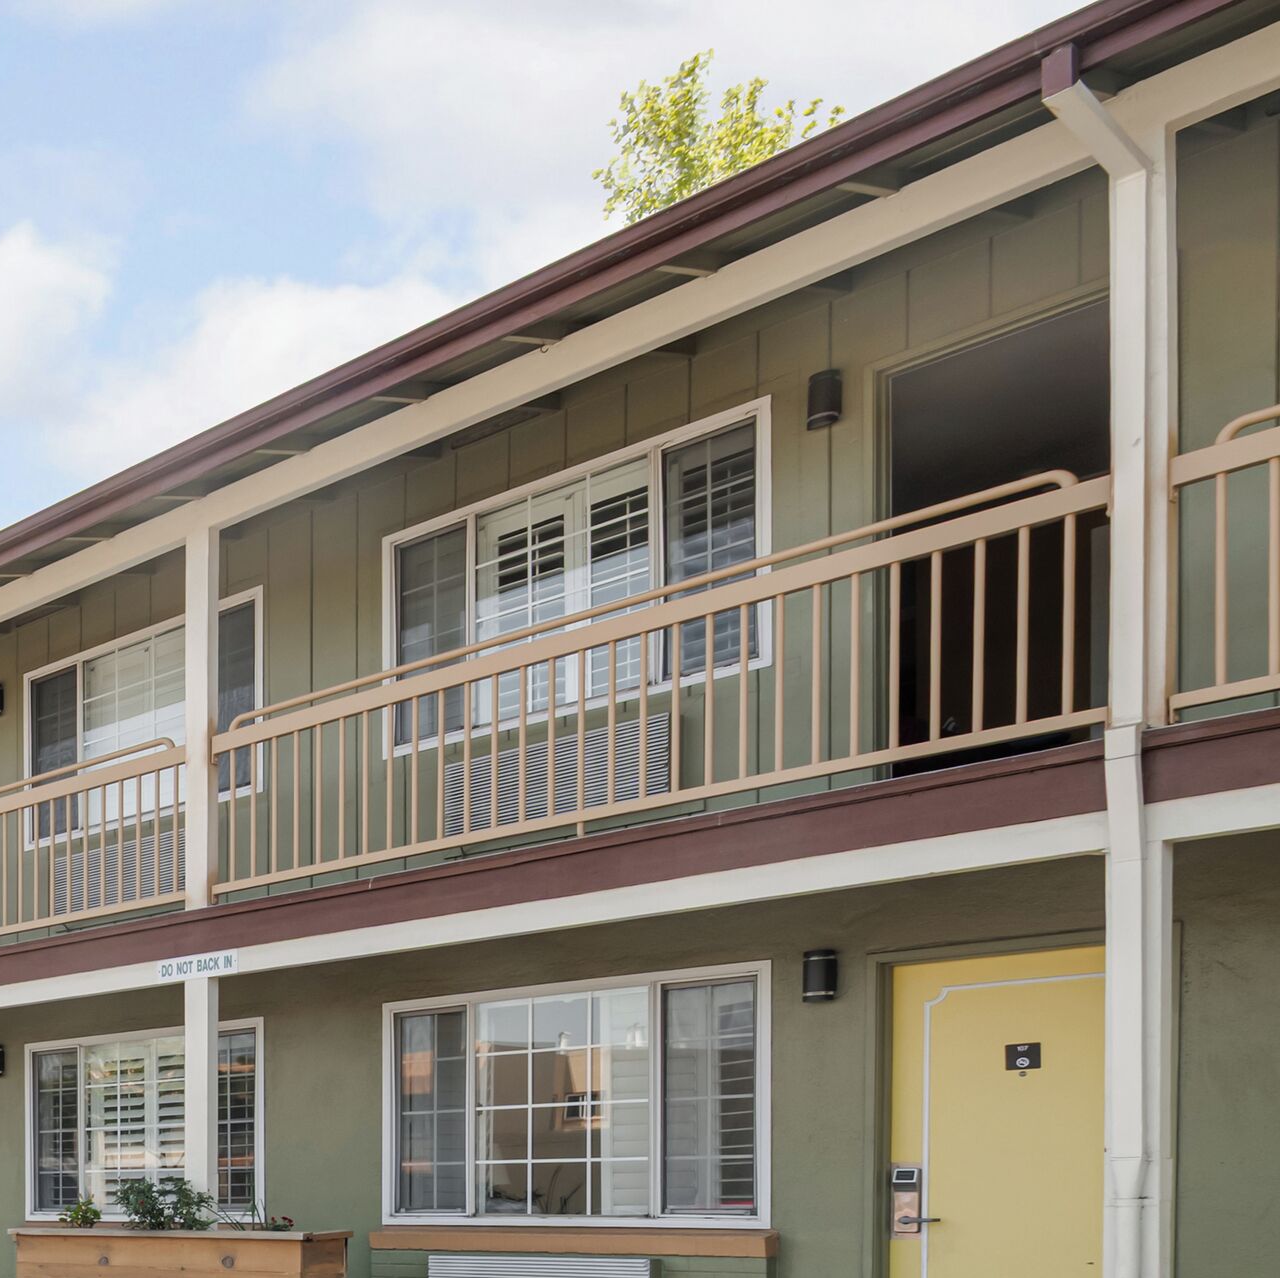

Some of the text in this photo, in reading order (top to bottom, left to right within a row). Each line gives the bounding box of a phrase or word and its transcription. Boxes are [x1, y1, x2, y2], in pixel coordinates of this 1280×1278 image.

[161, 954, 233, 977] DO NOT BACK IN
